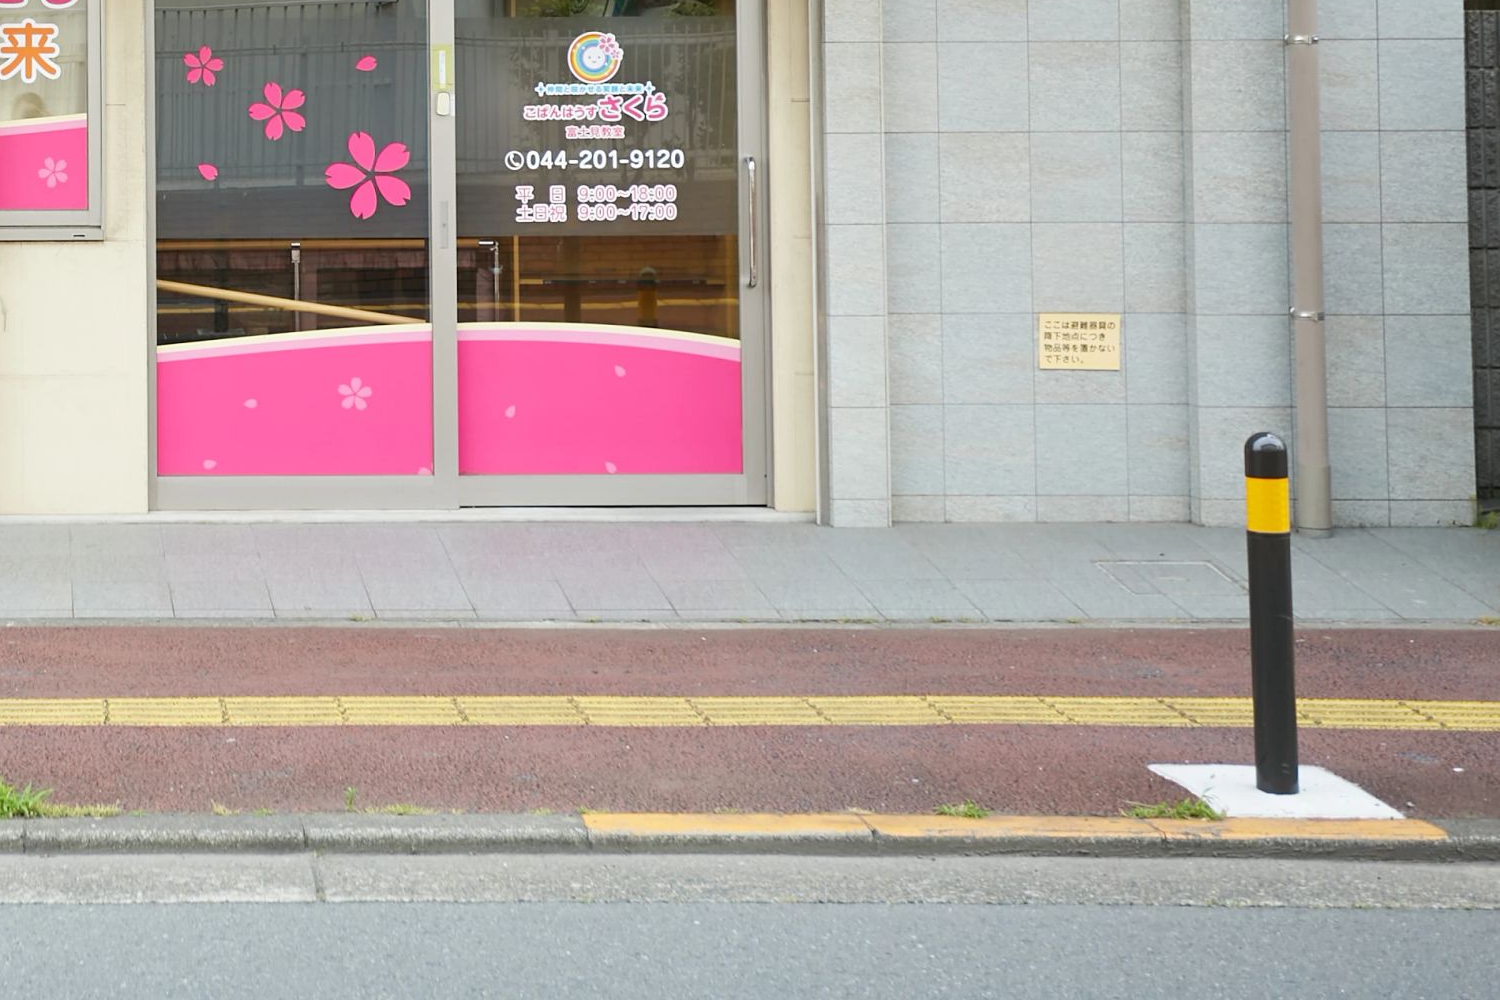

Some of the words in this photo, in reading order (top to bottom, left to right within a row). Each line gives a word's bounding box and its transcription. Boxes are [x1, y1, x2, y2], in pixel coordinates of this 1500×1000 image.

[566, 126, 625, 139] 富士見教室
[526, 150, 685, 169] 044-201-9120
[516, 204, 567, 222] 土日祝
